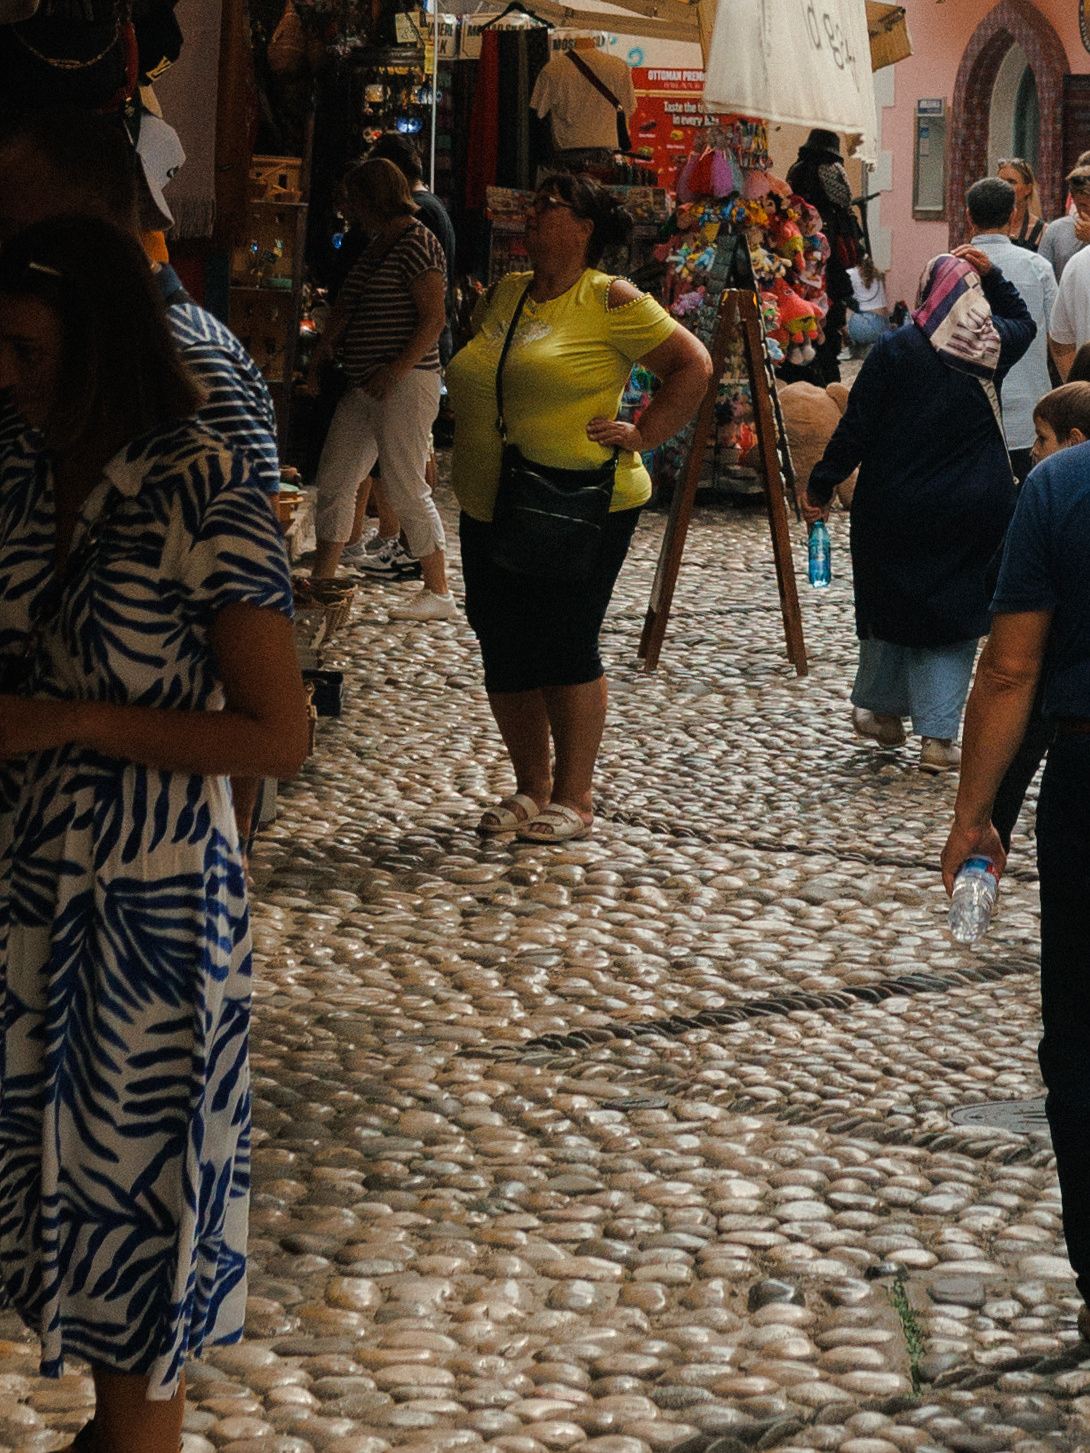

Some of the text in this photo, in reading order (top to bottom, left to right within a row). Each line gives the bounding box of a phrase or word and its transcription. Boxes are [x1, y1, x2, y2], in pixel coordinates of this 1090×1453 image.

[647, 69, 681, 81] OTTOMAN
[664, 101, 683, 113] Taste
[684, 102, 697, 113] the
